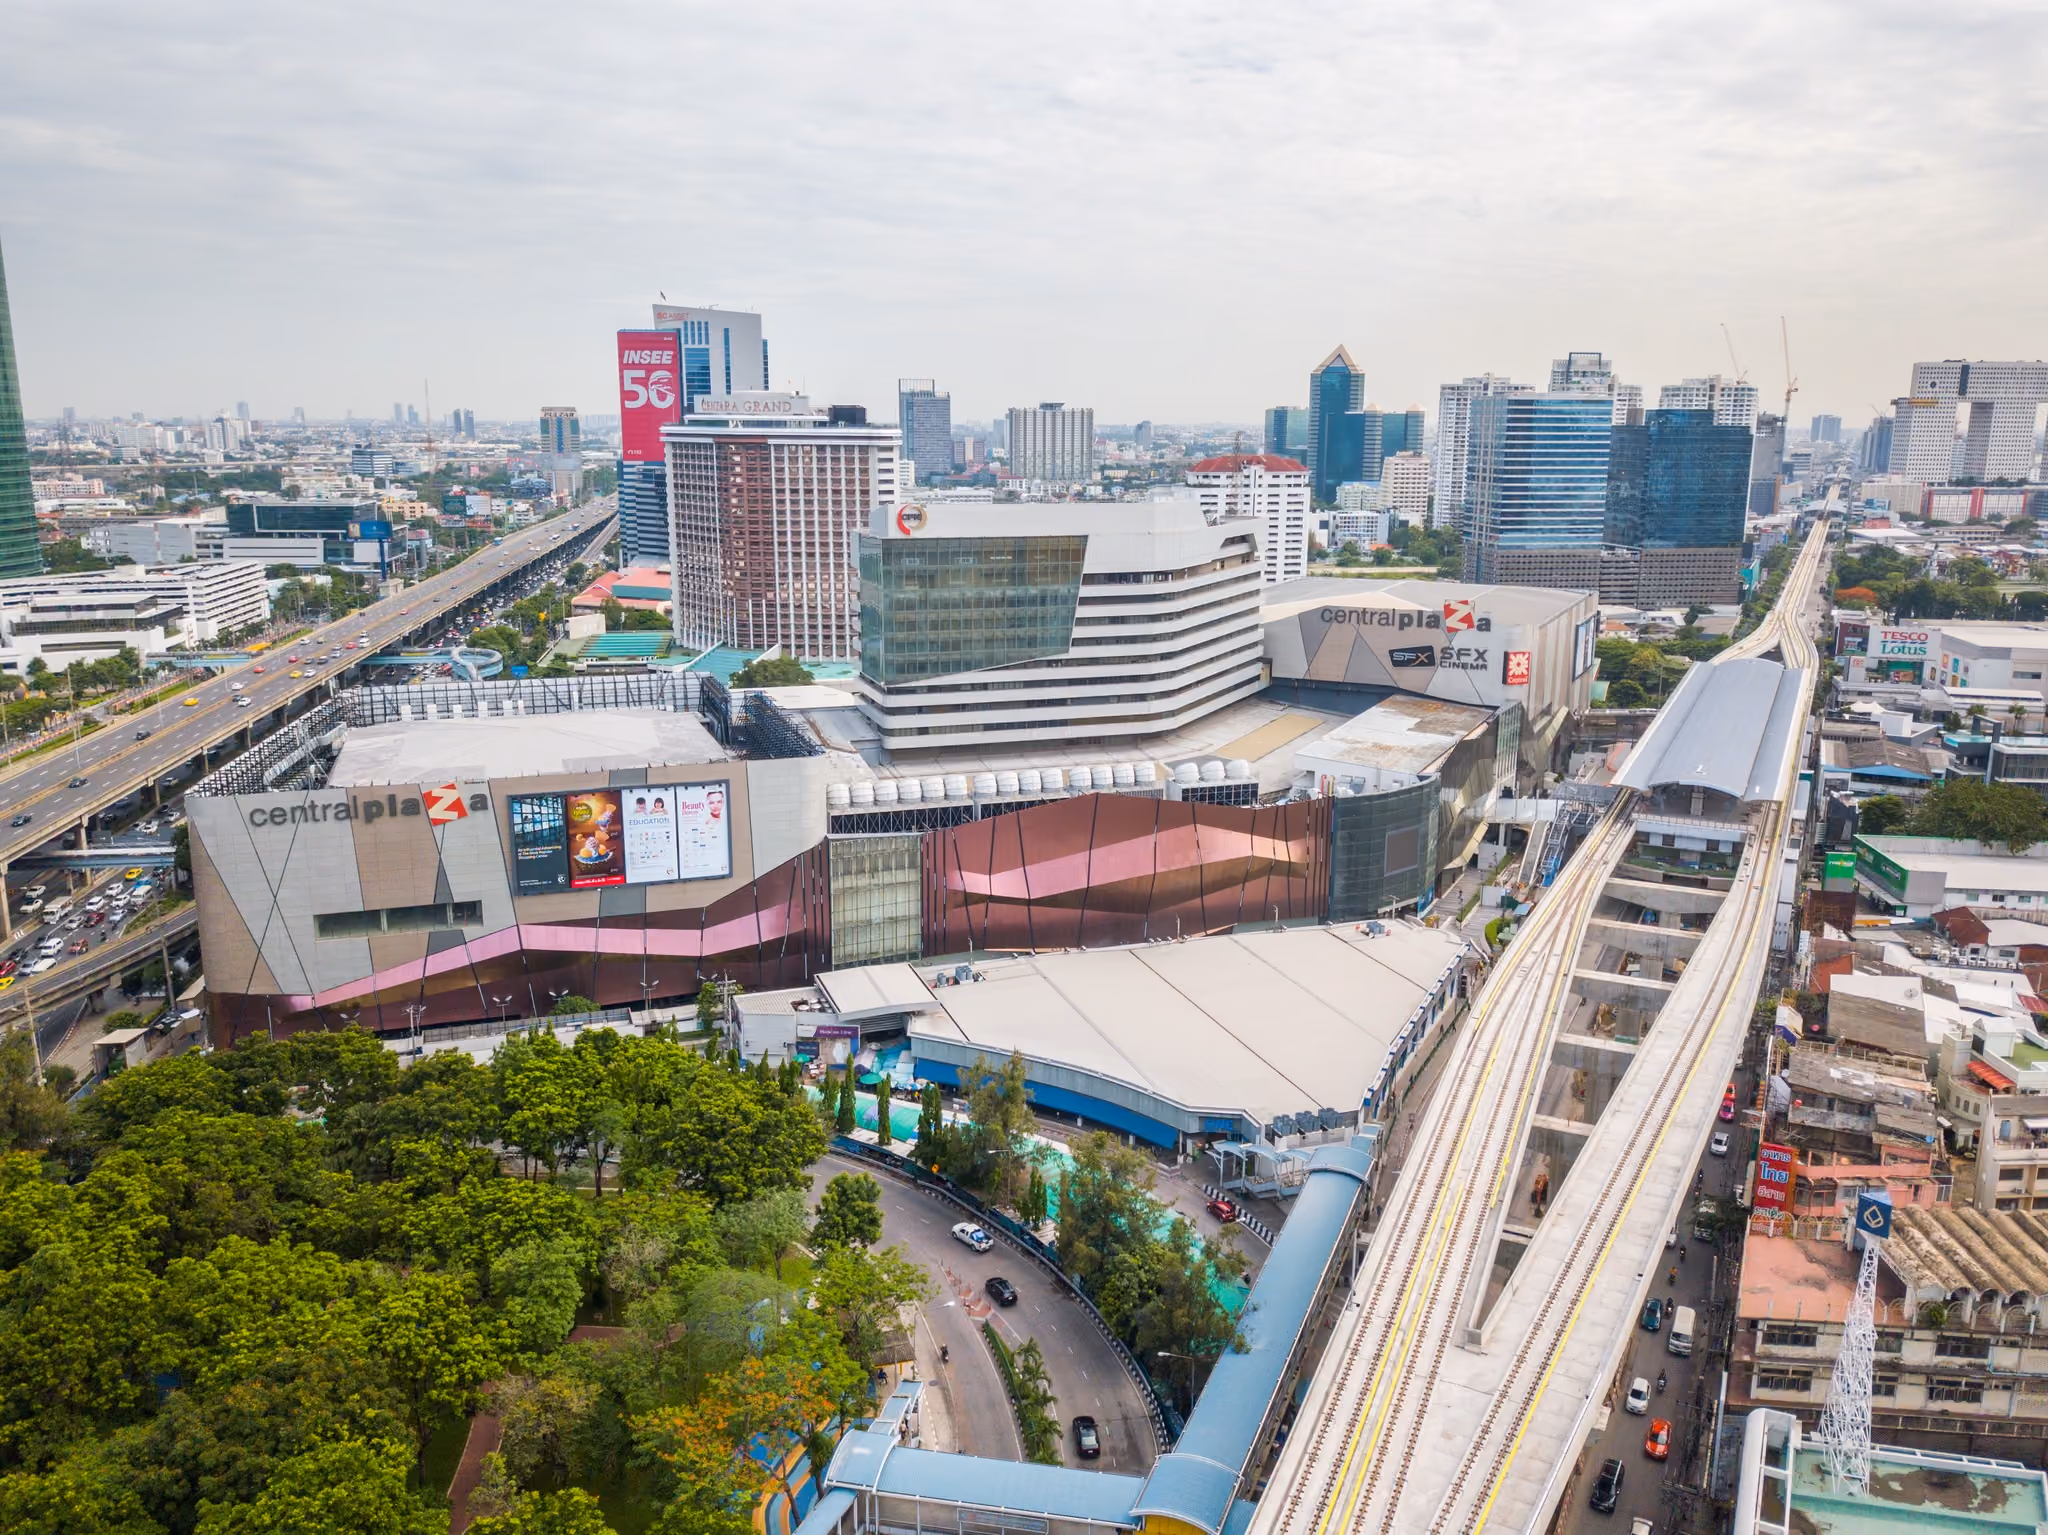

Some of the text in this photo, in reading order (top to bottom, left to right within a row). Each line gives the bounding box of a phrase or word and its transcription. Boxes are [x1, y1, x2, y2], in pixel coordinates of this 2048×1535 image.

[622, 350, 673, 365] INSEE
[623, 369, 675, 409] 50
[701, 398, 792, 413] CENTARA GRAND
[1881, 631, 1929, 642] TESCO
[1392, 647, 1488, 667] SFX SFX
[1881, 643, 1927, 656] Lotus
[1439, 661, 1488, 671] CINEMA
[629, 817, 670, 826] EDUCATION
[1761, 1148, 1792, 1163] อาหาร
[1760, 1161, 1789, 1183] ไทย
